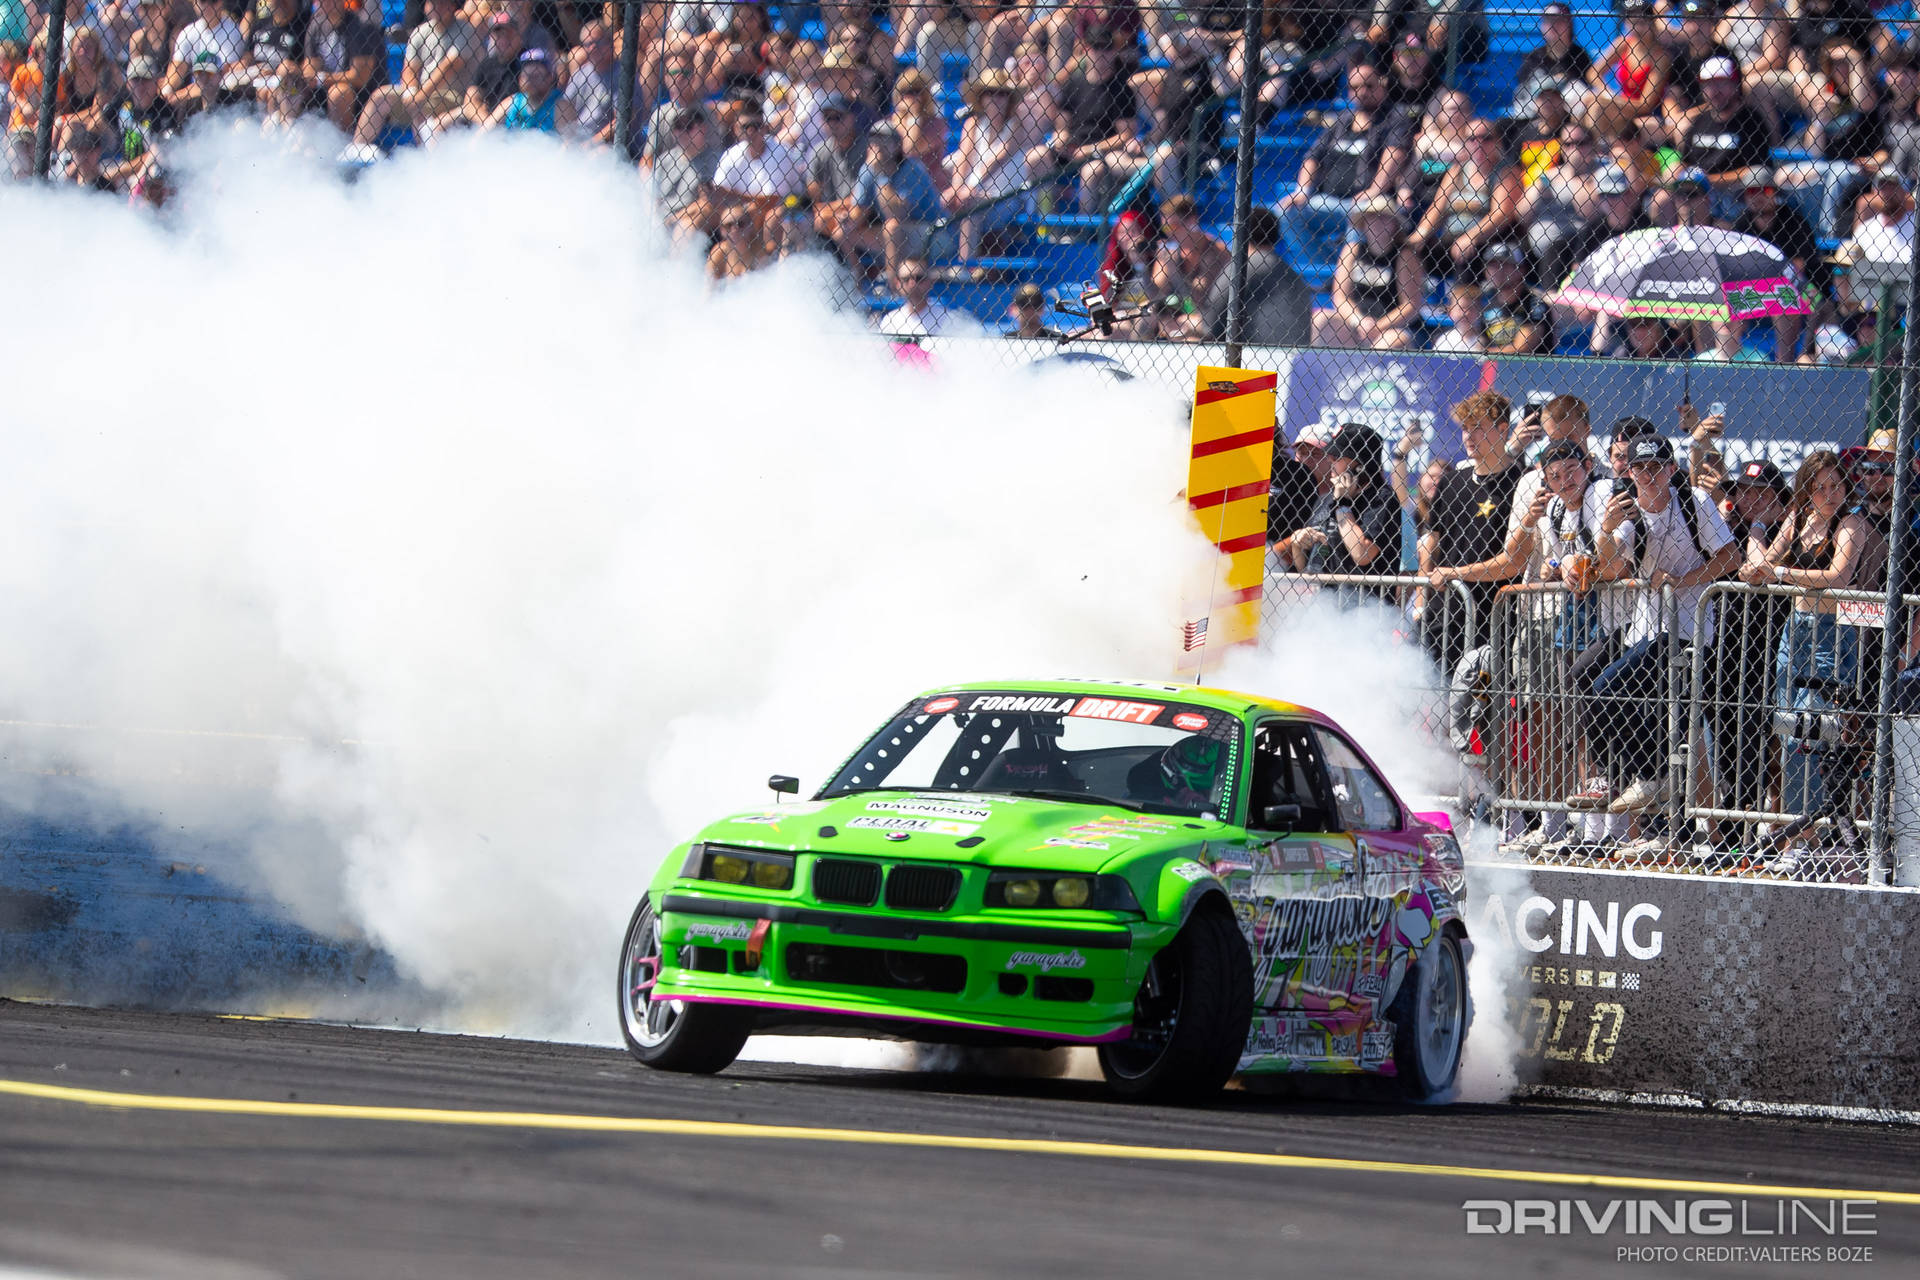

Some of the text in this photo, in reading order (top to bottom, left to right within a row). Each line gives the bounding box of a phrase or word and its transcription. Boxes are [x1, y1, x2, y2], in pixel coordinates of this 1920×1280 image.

[1840, 600, 1884, 615] NATIONAL
[968, 696, 1077, 714] FORMULA
[1077, 699, 1160, 723] DRIFT
[869, 802, 988, 817] MAGNUSON
[1479, 894, 1663, 960] ACING
